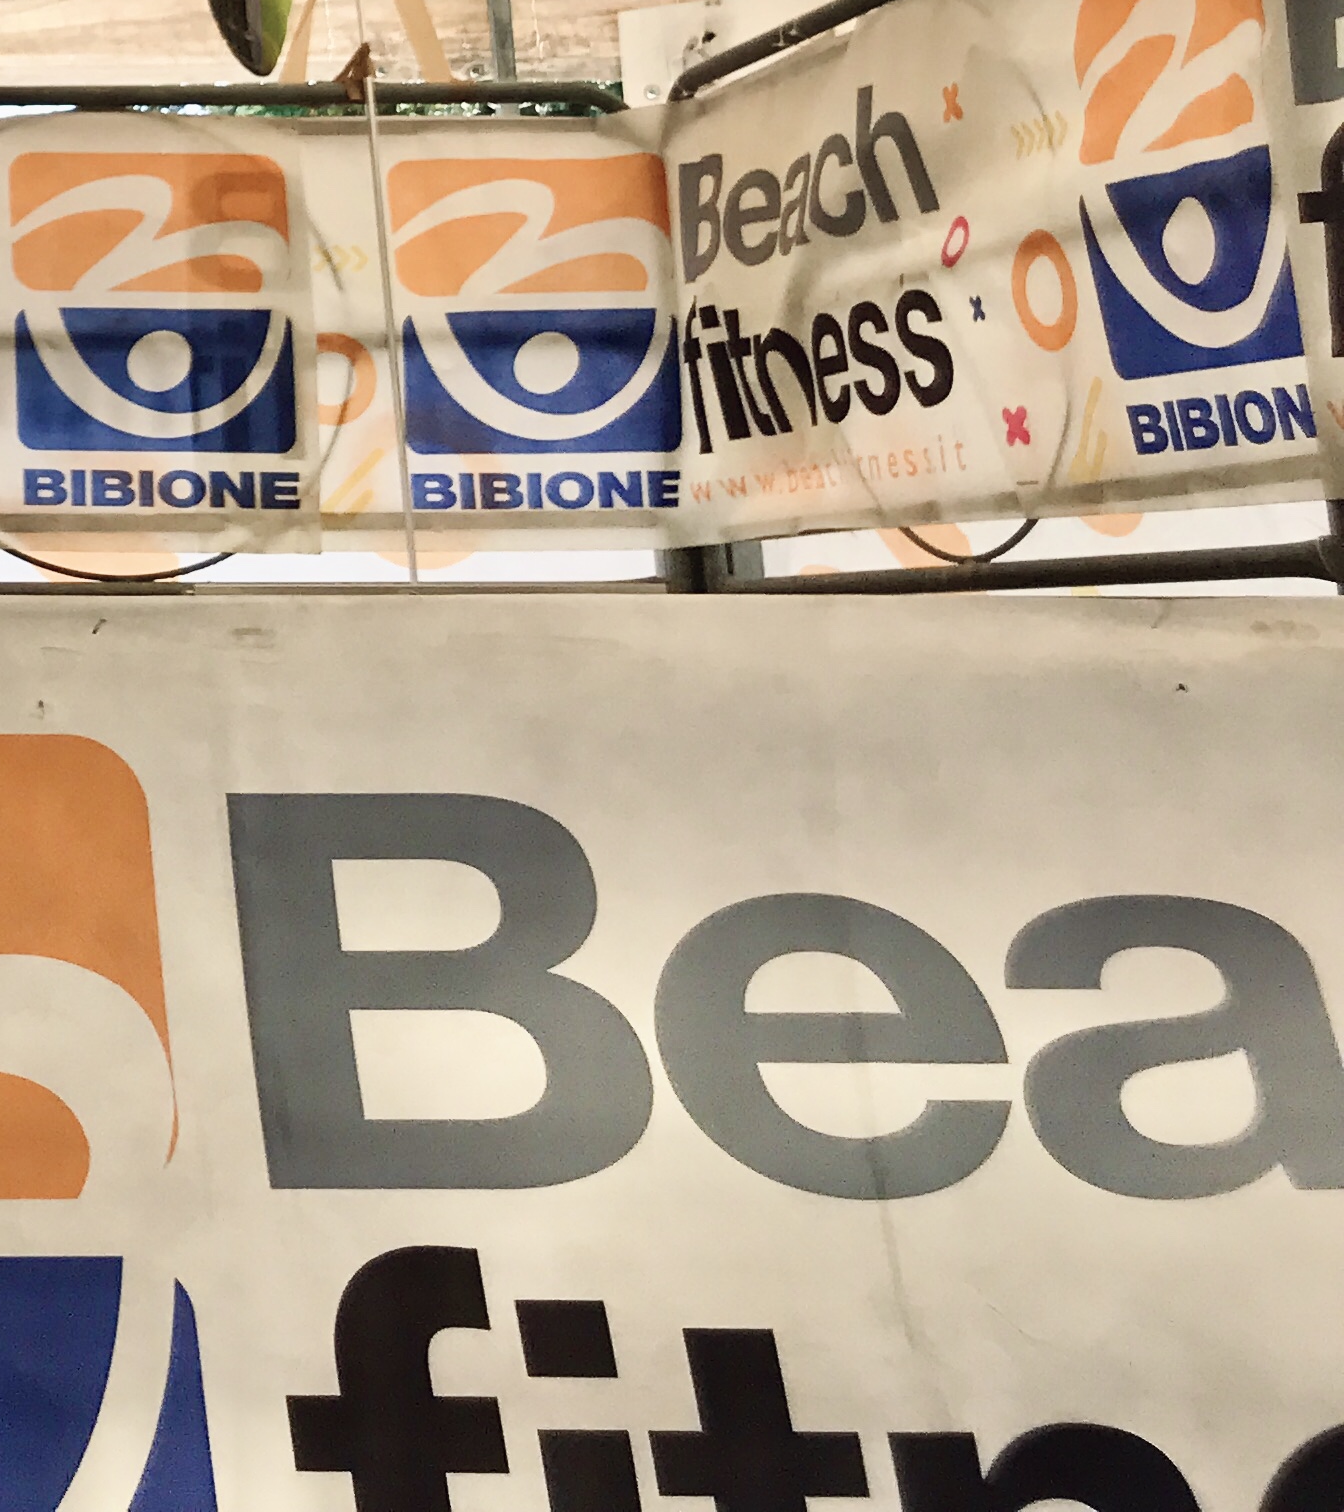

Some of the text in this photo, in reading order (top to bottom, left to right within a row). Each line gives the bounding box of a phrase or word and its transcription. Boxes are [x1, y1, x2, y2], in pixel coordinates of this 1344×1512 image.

[678, 84, 940, 284] Beach
[683, 288, 955, 455] fitness
[23, 468, 301, 510] BIBIONE
[411, 470, 682, 510] BIBIONE
